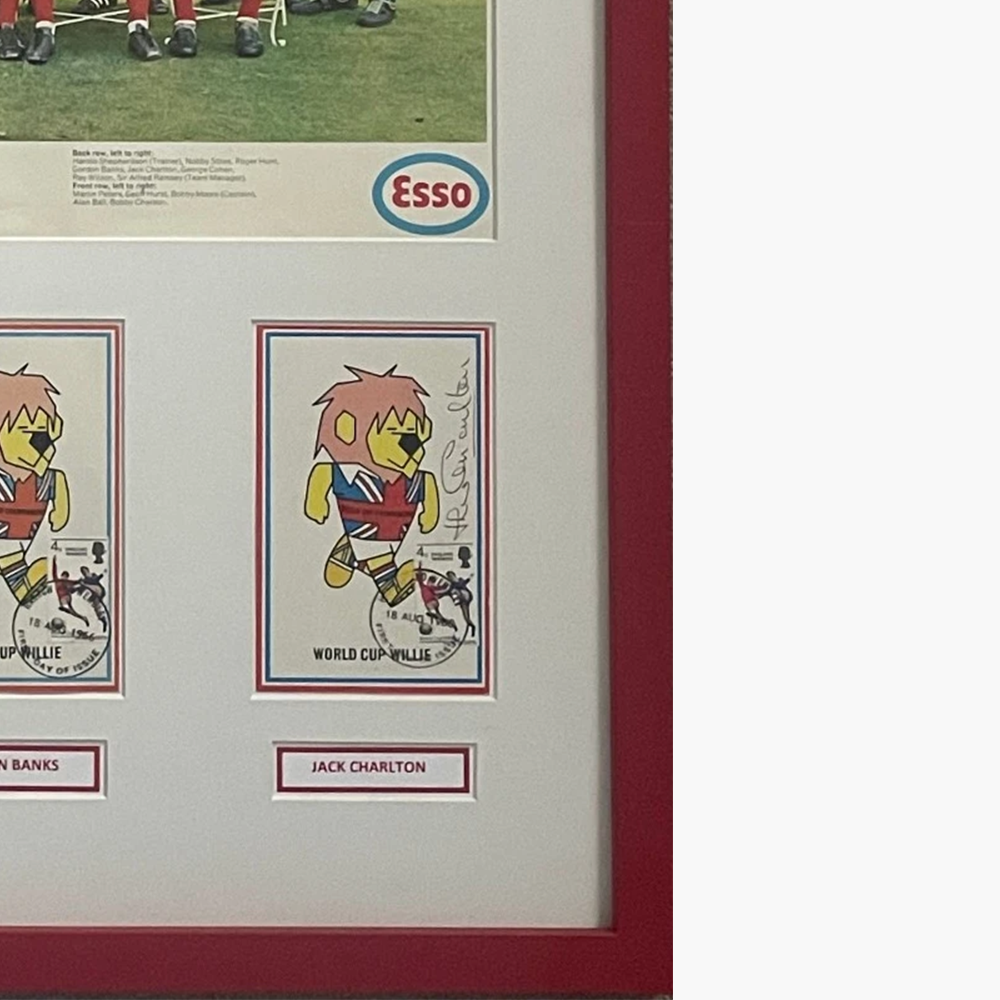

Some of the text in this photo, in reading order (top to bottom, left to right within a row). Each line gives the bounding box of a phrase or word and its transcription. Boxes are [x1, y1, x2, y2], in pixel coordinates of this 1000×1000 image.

[392, 175, 472, 208] Esso
[386, 610, 398, 620] 18
[401, 612, 424, 624] AUG
[21, 646, 62, 659] WILLIE
[313, 647, 432, 661] WORLD CUP WILLIE
[55, 666, 69, 675] OF
[72, 648, 101, 672] ISSUE
[12, 758, 60, 772] BANKS
[311, 759, 427, 774] JACK CHARLTON
